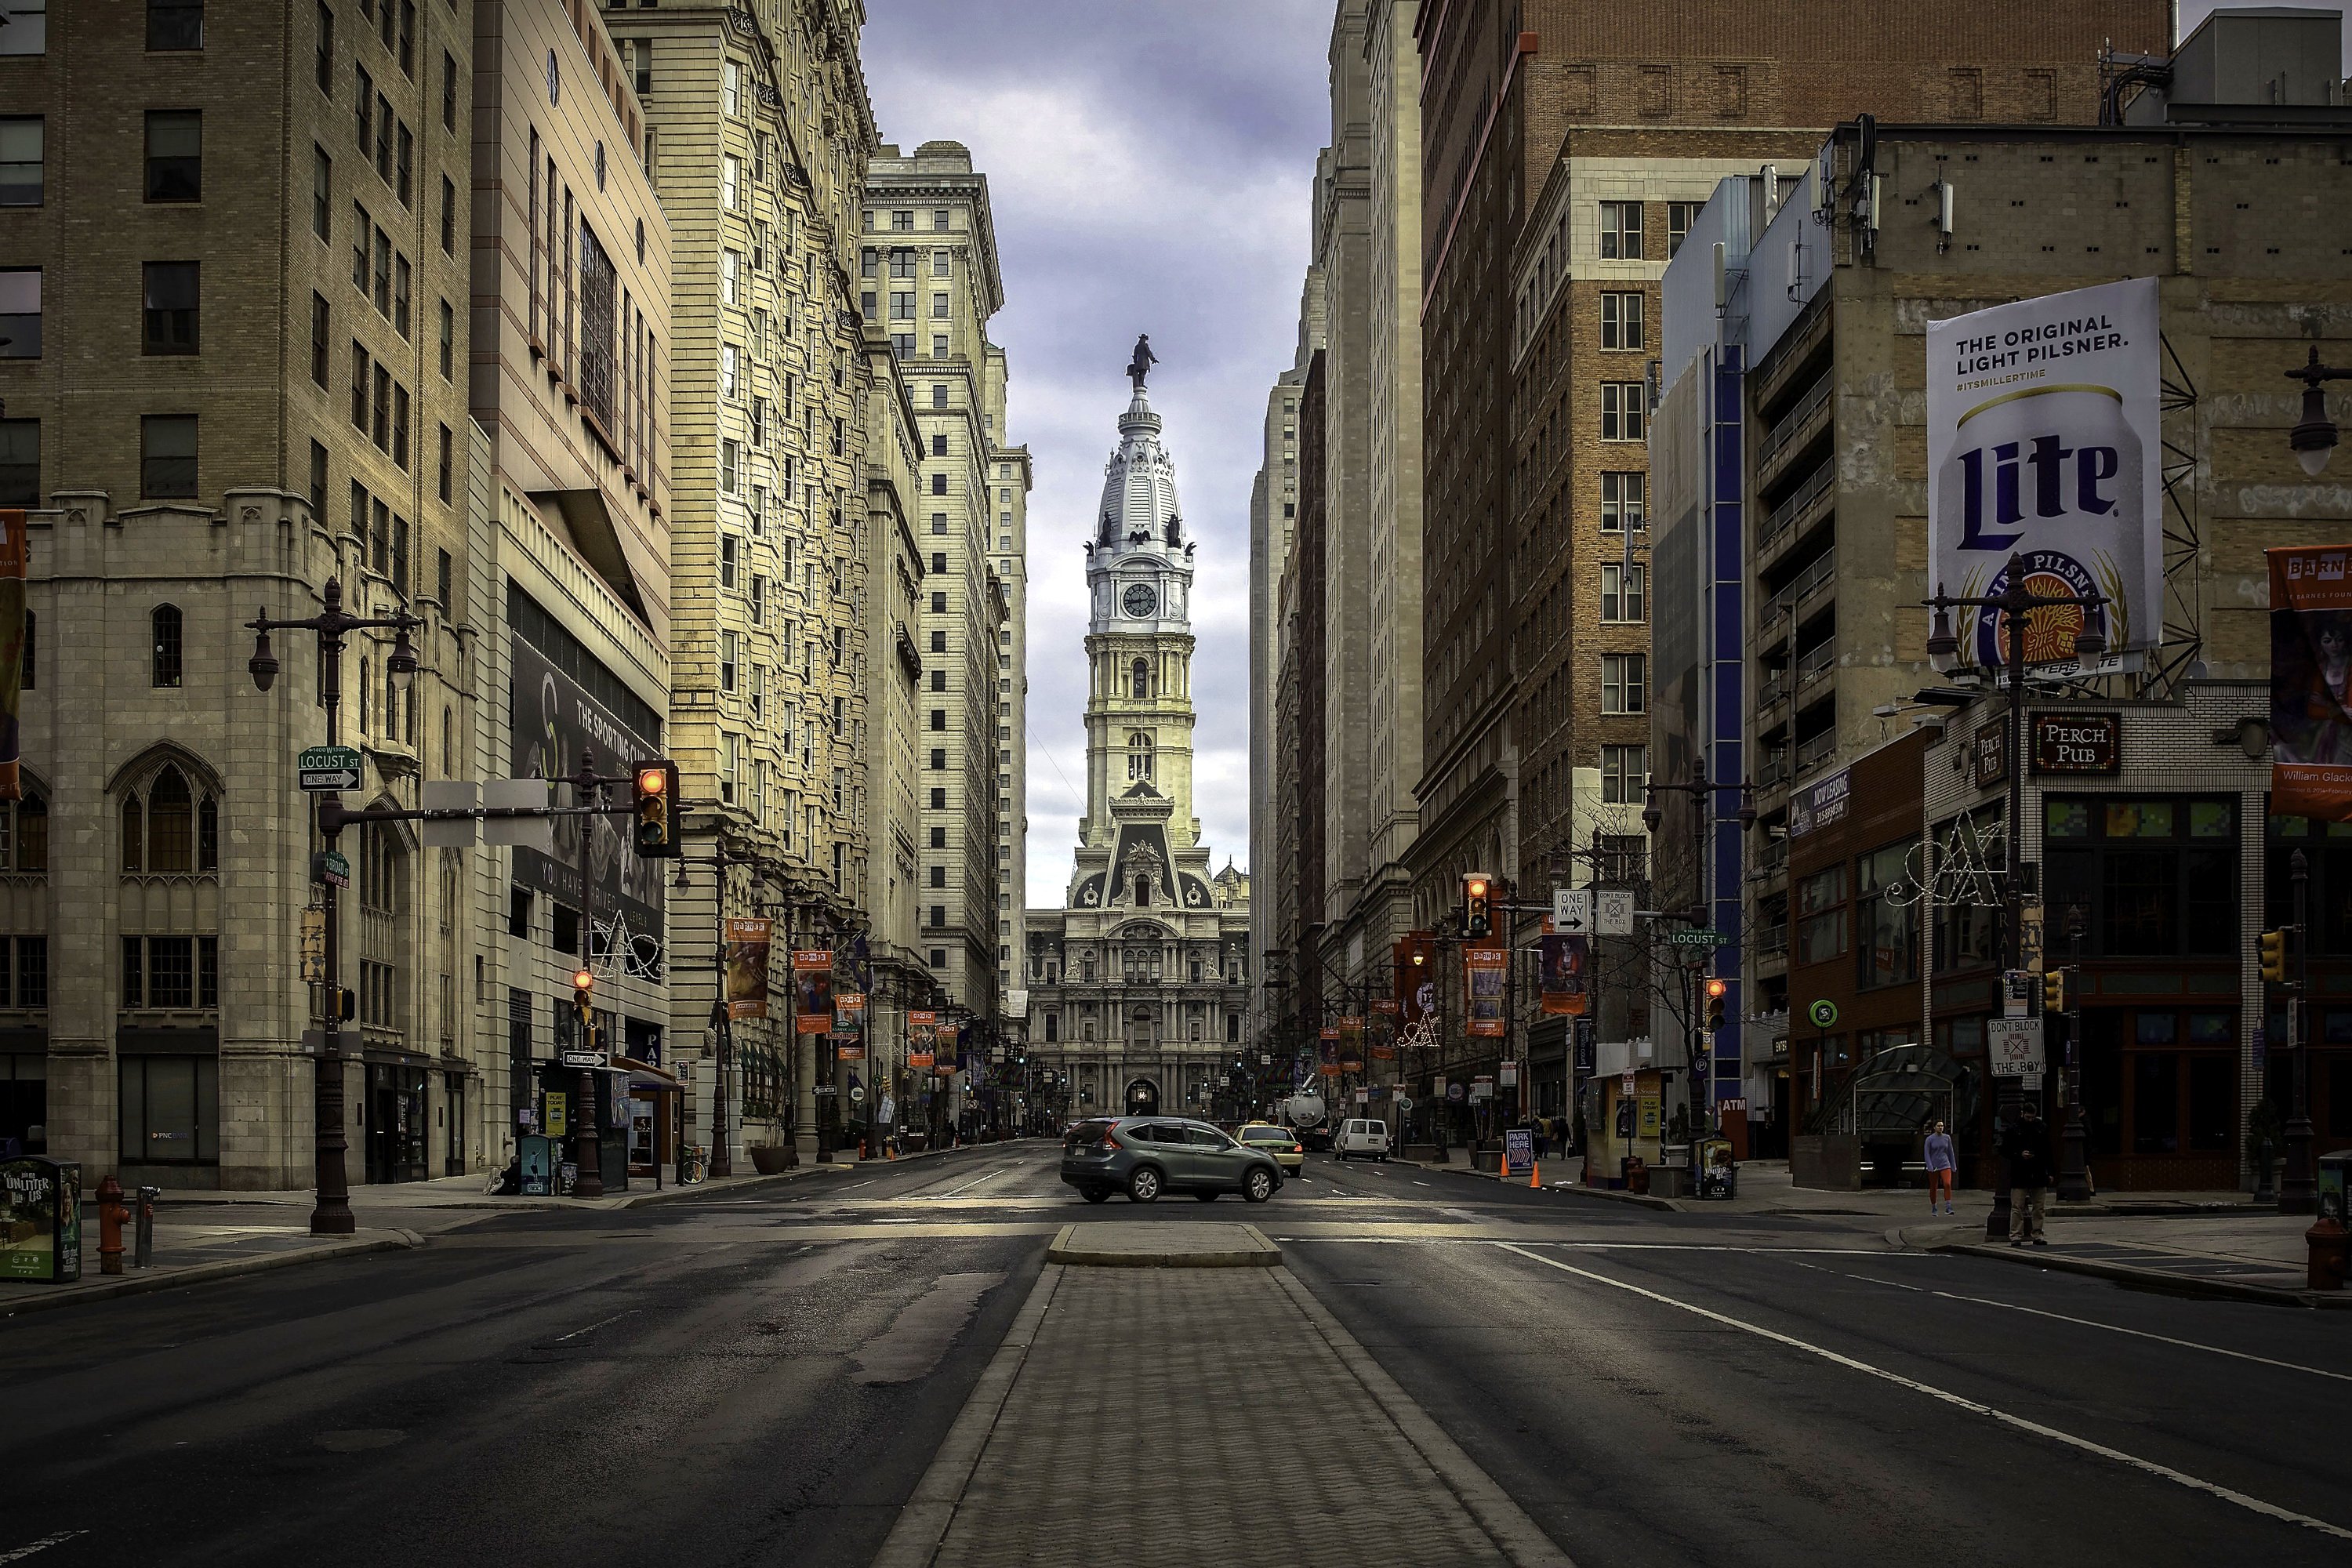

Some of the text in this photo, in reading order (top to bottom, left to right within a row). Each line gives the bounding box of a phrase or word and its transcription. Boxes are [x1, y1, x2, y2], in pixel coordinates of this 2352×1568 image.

[1956, 314, 2112, 355] THE ORIGINAL
[1956, 332, 2129, 376] LIGHT PILSNER.
[1956, 368, 2046, 392] #ITSMILLERTIME
[1957, 435, 2118, 551] Lite
[577, 699, 593, 734] THE
[593, 713, 629, 763] SPORTING
[2045, 724, 2107, 744] PERCH
[1980, 735, 2001, 757] PERCH
[2056, 745, 2096, 763] PUB
[300, 755, 359, 768] LOCUST ST
[1984, 756, 1997, 774] PUB
[306, 775, 342, 784] ONE WAY
[2283, 771, 2319, 782] William
[1814, 774, 1848, 808] NOW LEASING
[329, 858, 343, 874] BROAD
[542, 861, 616, 913] YOU HAVE RRIVED
[1562, 895, 1582, 903] ONE
[1561, 906, 1583, 915] WAY
[1672, 935, 1715, 944] LOCUST
[2015, 1021, 2040, 1032] BLOCK
[1995, 1062, 2016, 1073] THE
[1723, 1099, 1746, 1111] ATM
[6, 1177, 49, 1191] UNLITTER
[28, 1190, 42, 1203] US
